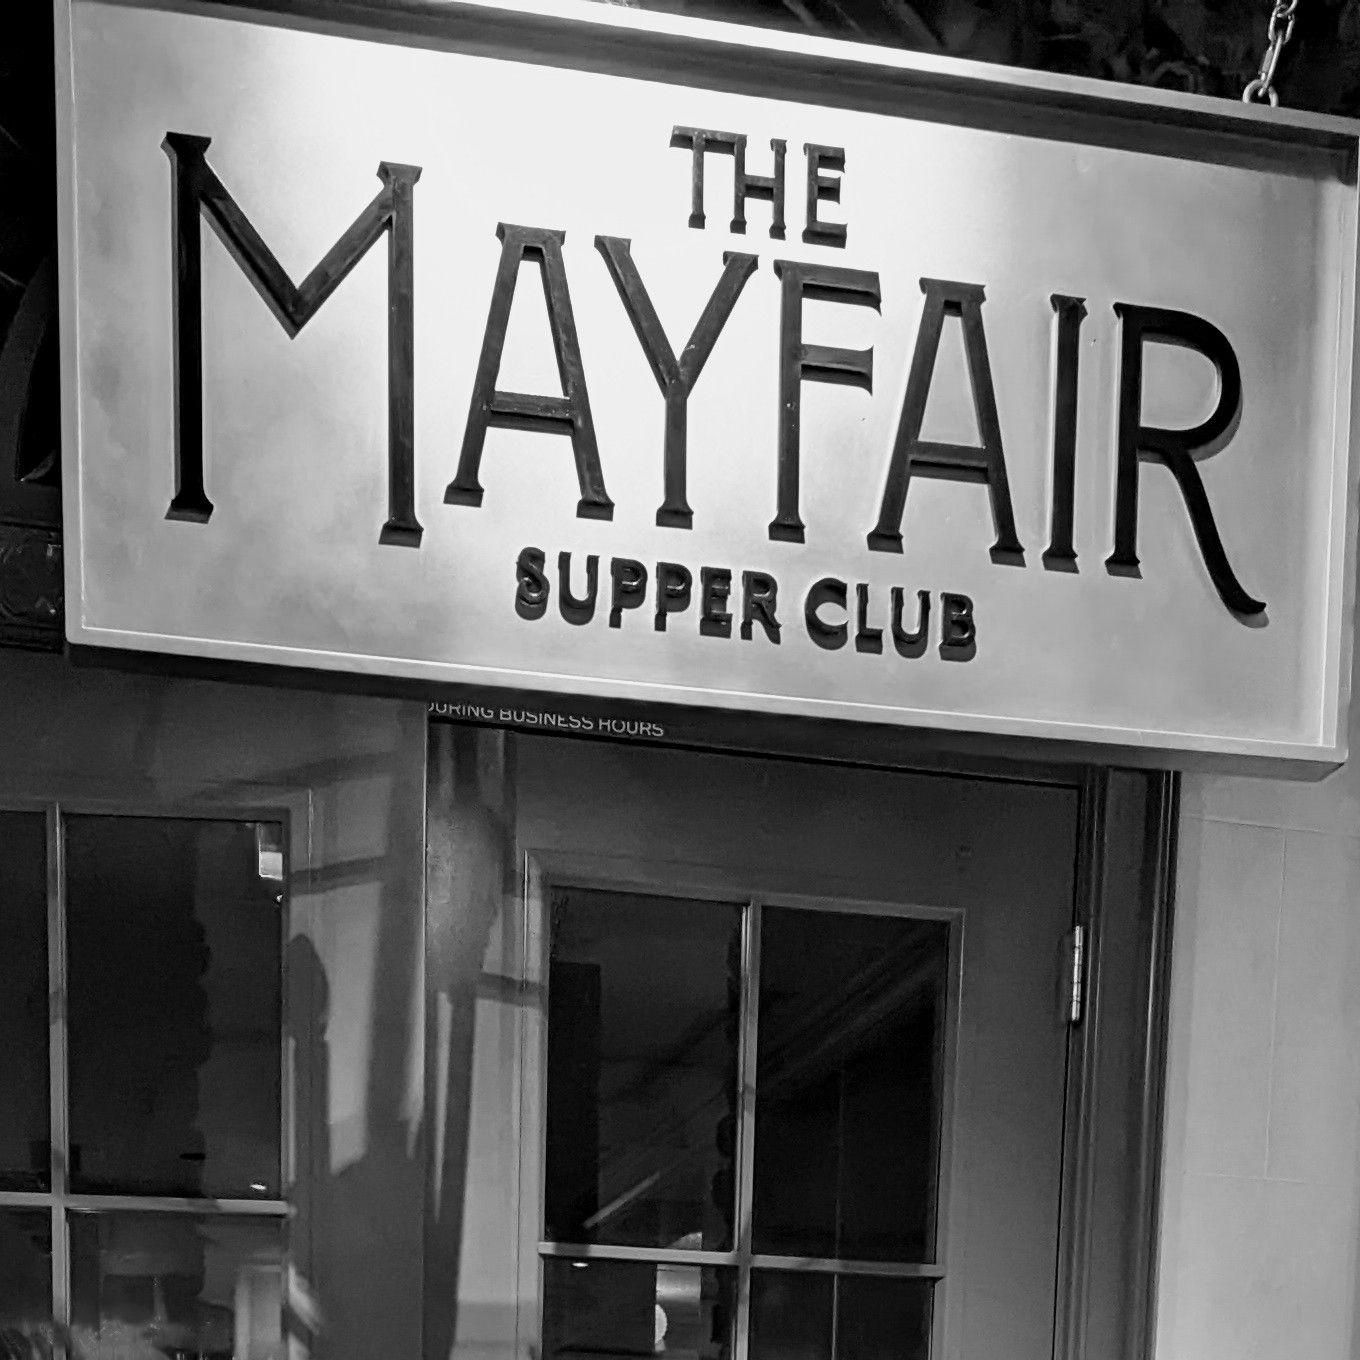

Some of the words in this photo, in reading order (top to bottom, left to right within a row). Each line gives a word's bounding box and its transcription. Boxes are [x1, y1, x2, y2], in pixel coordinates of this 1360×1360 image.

[669, 124, 849, 249] THE
[159, 130, 1271, 629] MAYFAIR
[514, 545, 784, 645] SUPPER
[804, 575, 979, 663] CLUB
[428, 702, 494, 719] URING
[499, 708, 594, 729] BUSINESS
[598, 719, 665, 738] HOURS
